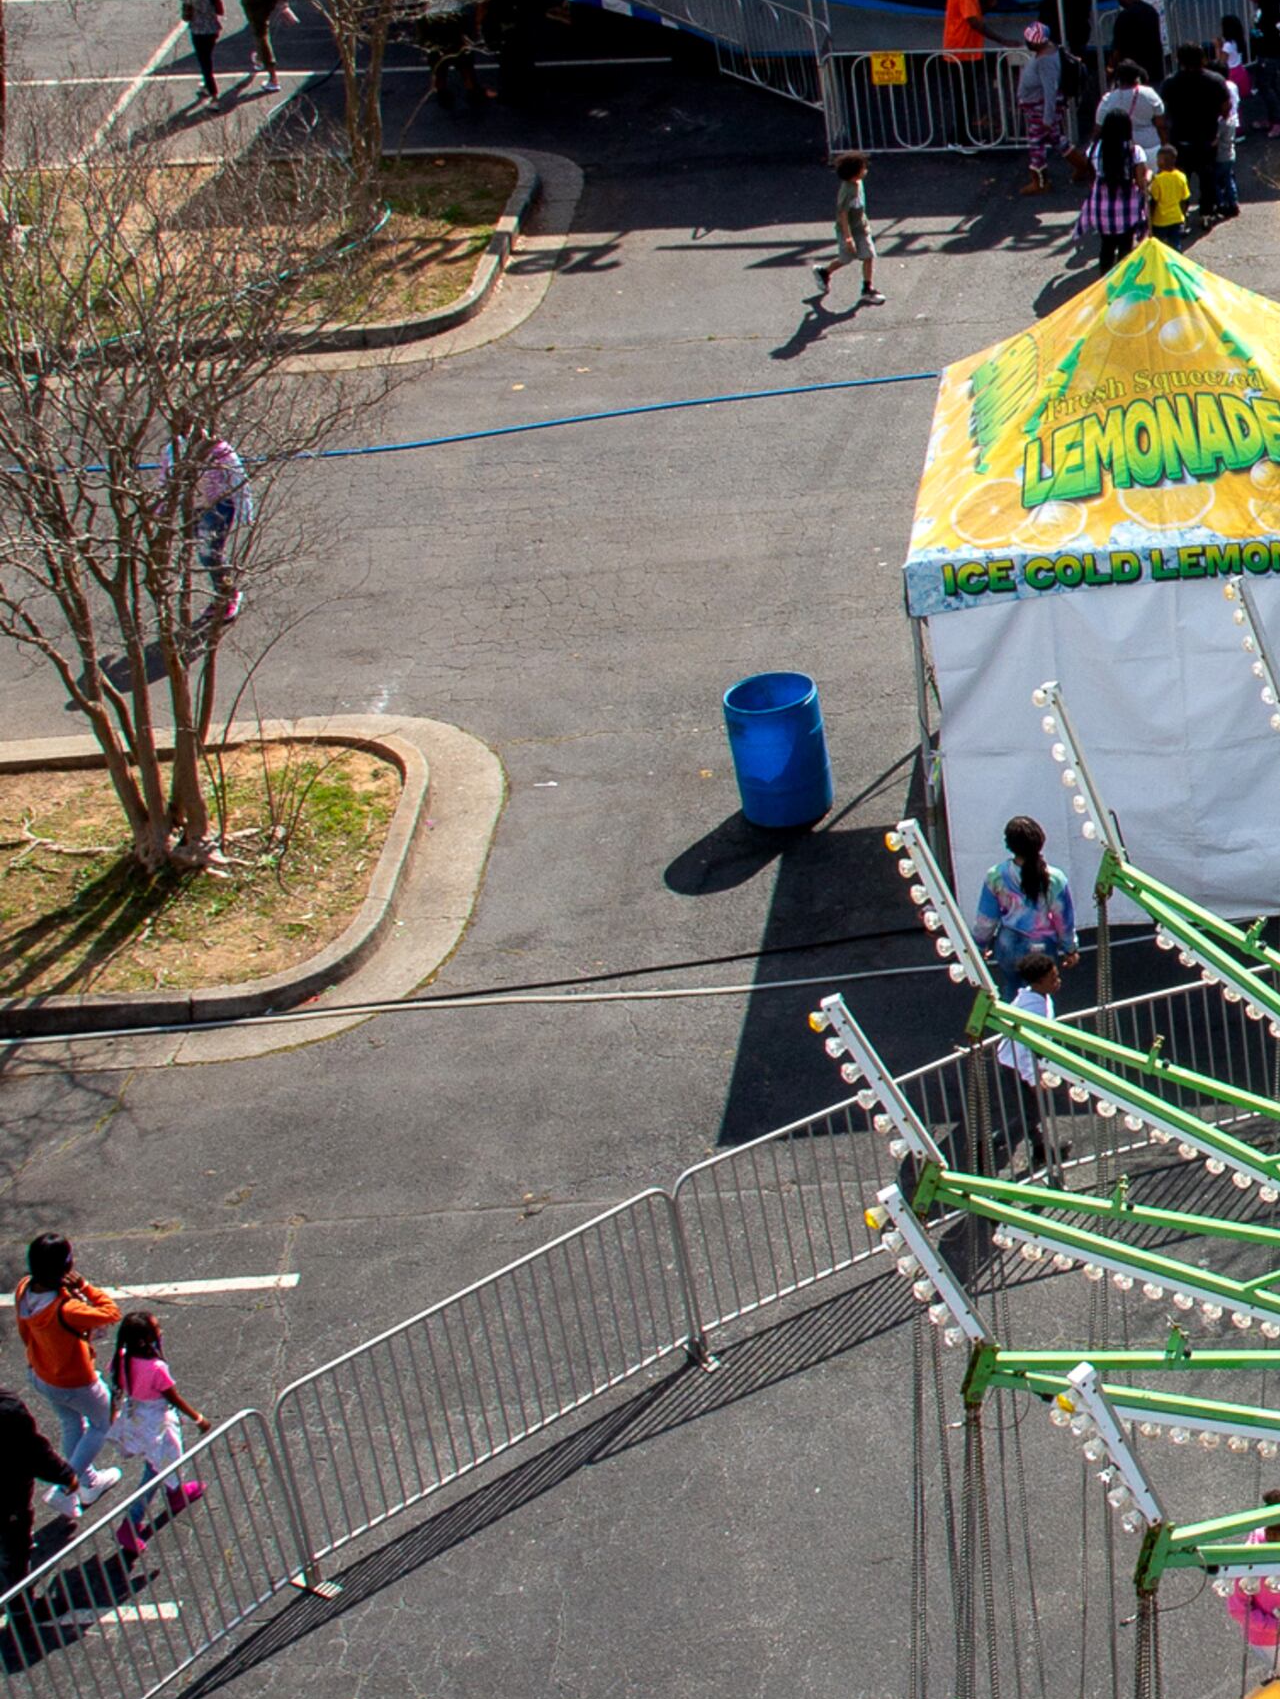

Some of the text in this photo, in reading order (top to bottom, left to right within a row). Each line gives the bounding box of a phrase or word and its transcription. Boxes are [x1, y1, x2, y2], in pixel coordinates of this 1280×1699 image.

[1041, 369, 1268, 423] Fresh Squeezed
[942, 559, 1017, 597] ICE
[1023, 549, 1143, 590] COLD
